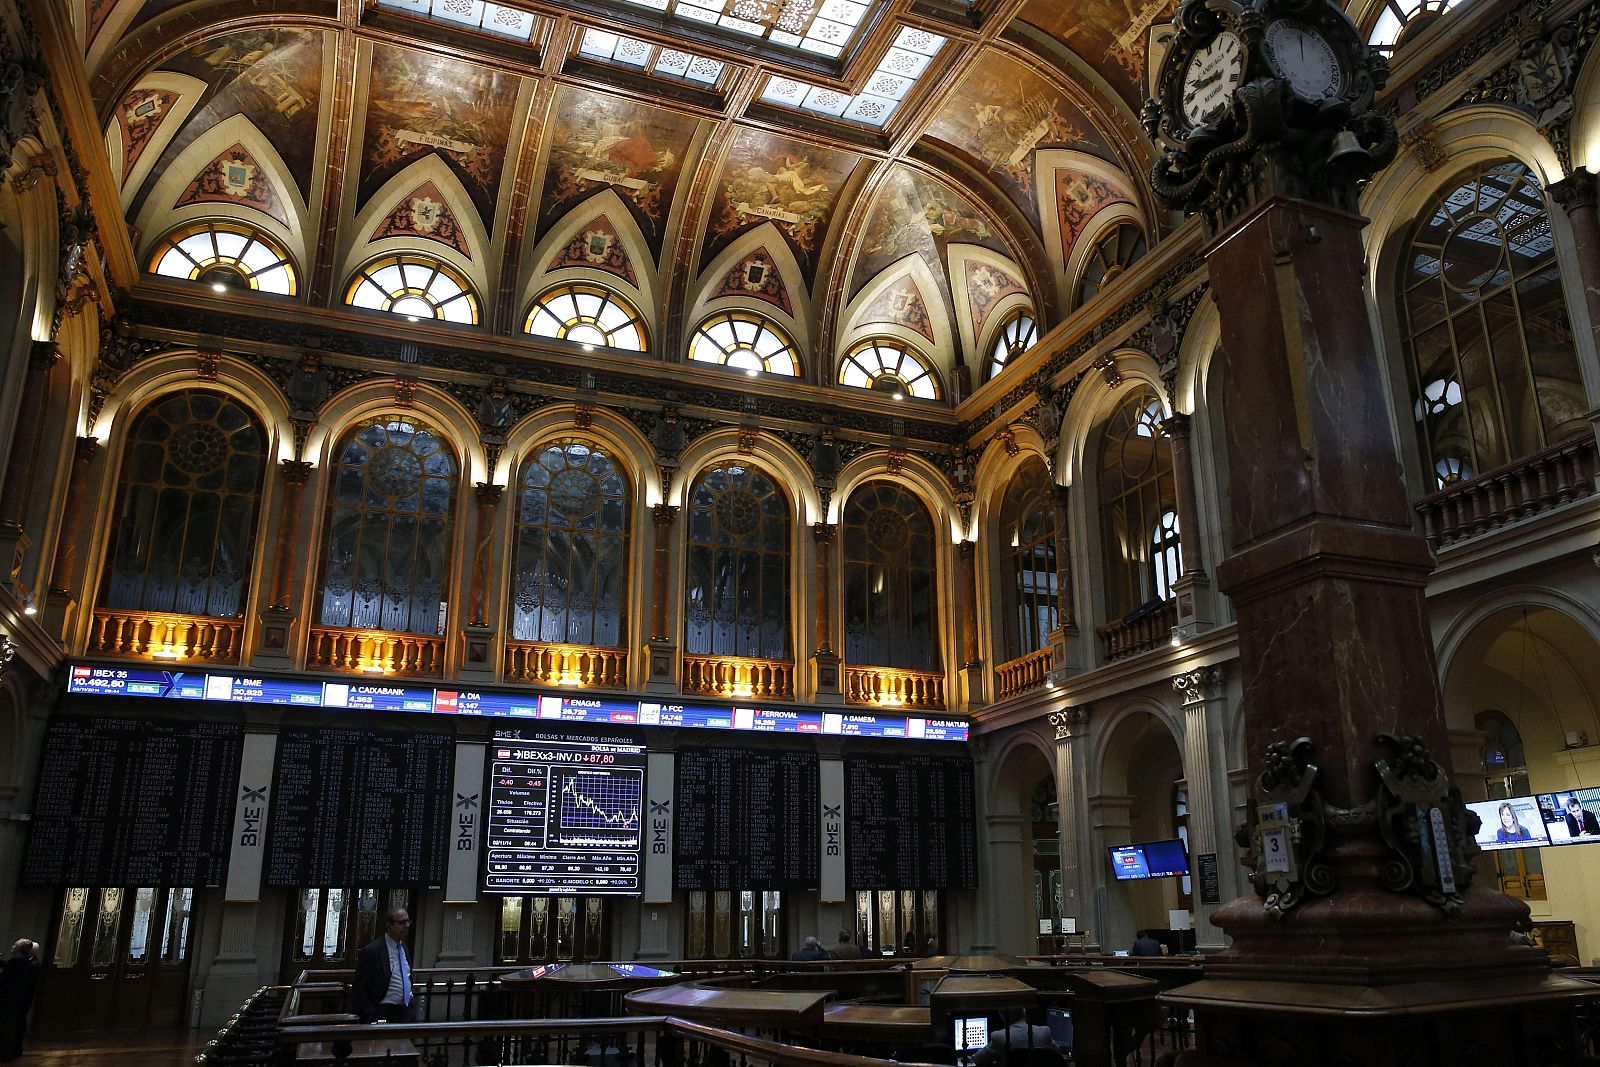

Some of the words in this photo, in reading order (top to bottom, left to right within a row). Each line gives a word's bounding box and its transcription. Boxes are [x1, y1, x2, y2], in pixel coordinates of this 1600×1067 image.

[93, 669, 115, 678] IBEX
[116, 671, 128, 679] 35
[242, 678, 263, 687] BME
[358, 686, 405, 696] CAIXABANK
[467, 692, 481, 701] DIA
[458, 702, 479, 710] 5,147
[570, 699, 602, 708] ENAGAS
[668, 705, 684, 713] FCC
[761, 710, 798, 719] FERROVIAL
[849, 715, 876, 723] GAMESA
[932, 720, 946, 728] GAS
[946, 721, 970, 729] NATURA
[600, 736, 633, 744] ESPAÑOLES
[617, 746, 641, 754] MADRID
[590, 754, 614, 764] 87,80
[527, 767, 542, 775] Dif.%
[240, 806, 261, 847] BME
[457, 813, 474, 851] BME
[652, 818, 666, 854] BME
[826, 822, 839, 856] BME
[1270, 837, 1280, 853] 3
